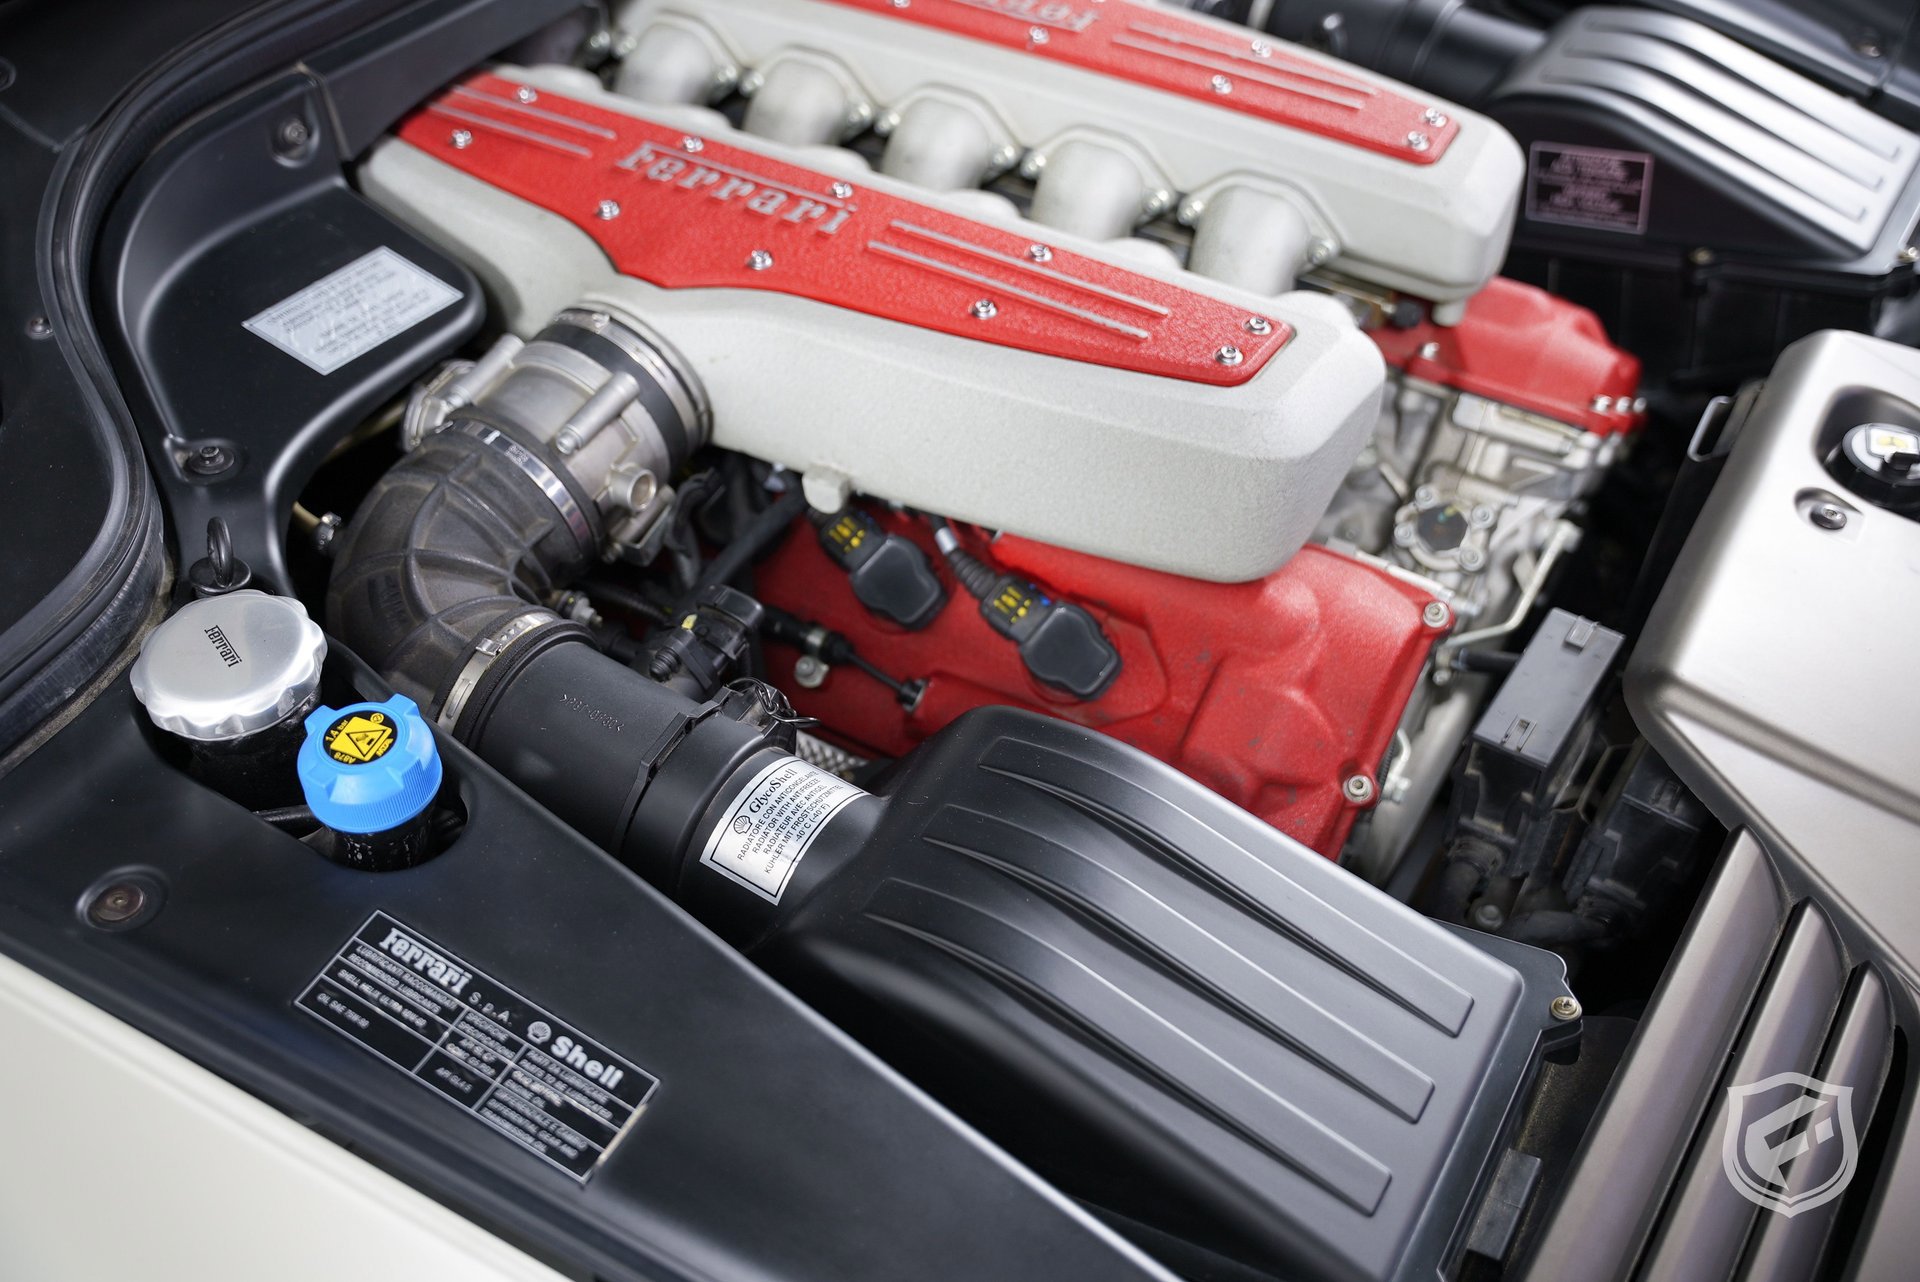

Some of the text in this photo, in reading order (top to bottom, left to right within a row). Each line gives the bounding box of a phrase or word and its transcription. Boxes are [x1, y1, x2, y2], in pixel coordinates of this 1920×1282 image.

[615, 140, 858, 235] Ferrari
[203, 624, 243, 668] Ferrari
[737, 771, 818, 861] RADIATORE CON ANTICONGELANTE
[749, 768, 797, 813] GlycoShell
[752, 778, 819, 854] RADIATOR WITH ANTIFREEZE
[764, 784, 827, 855] RADIATEUR AVEC ANTIGEL
[784, 830, 794, 844] MIT
[791, 784, 843, 830] FROSTSCHUTZMITTEL
[337, 968, 362, 988] SHELL
[378, 994, 404, 1014] ULTRA
[347, 953, 442, 1014] RECOMMENDED LUBRICANTS
[355, 945, 404, 978] LUBRIFICANTI
[378, 927, 473, 996] Ferrari
[328, 999, 346, 1014] SAE
[549, 1033, 625, 1091] Shell
